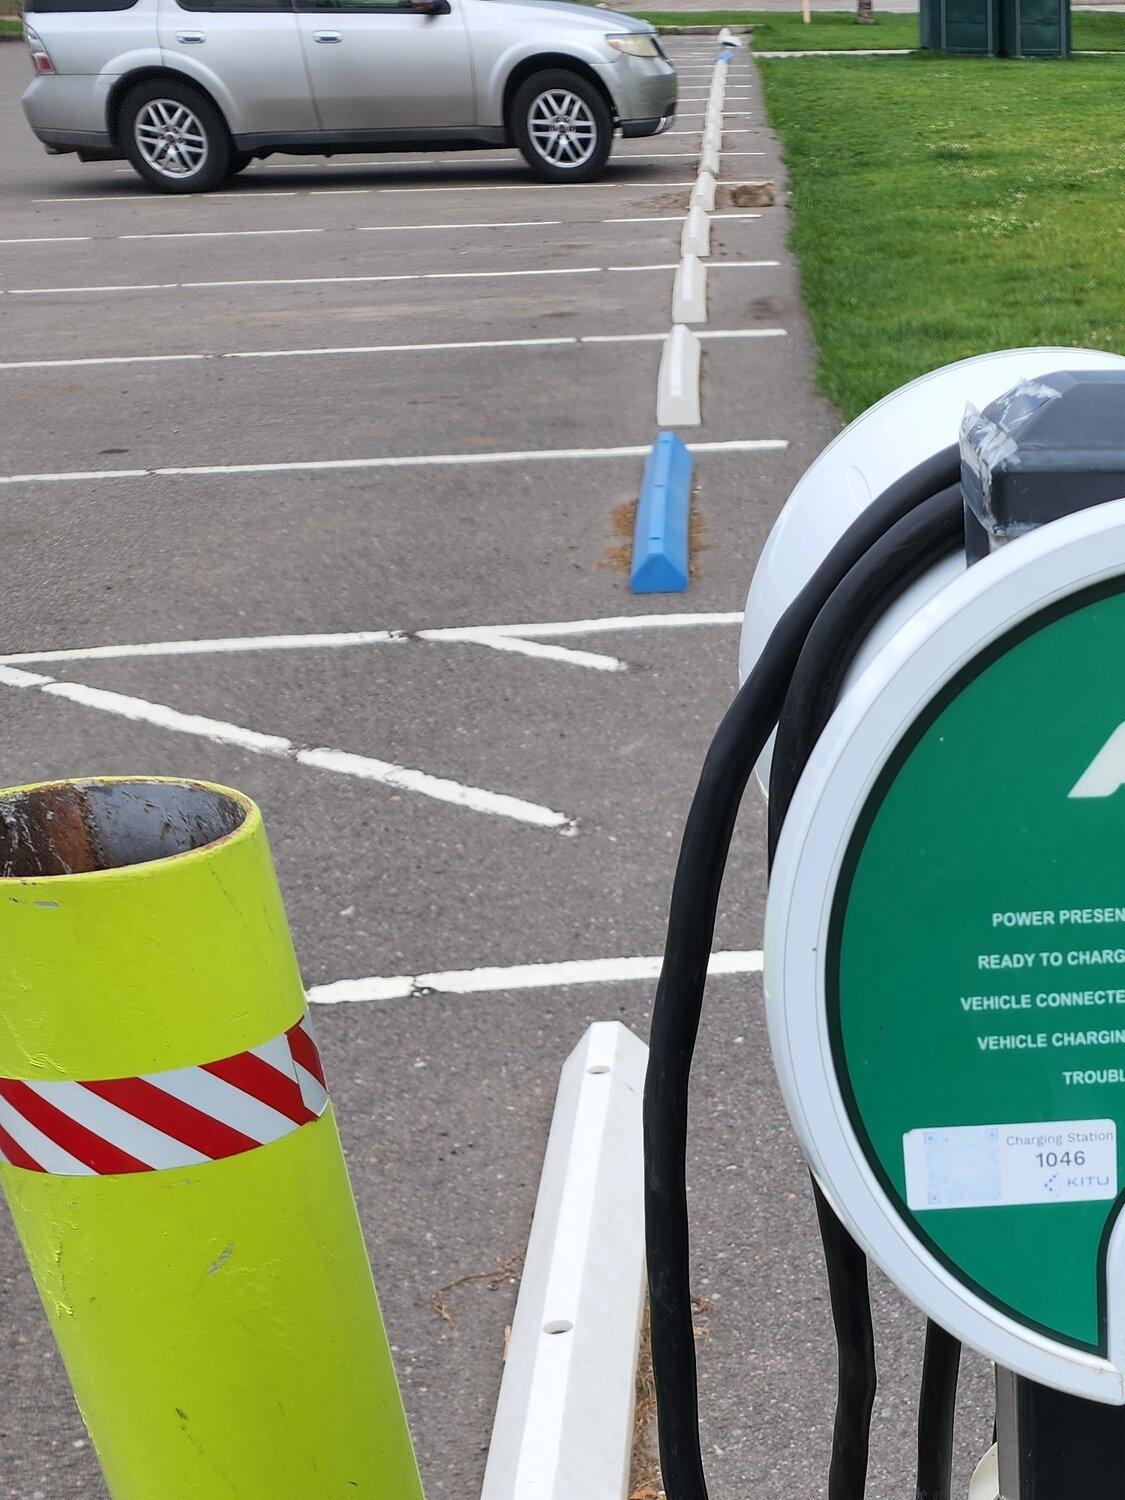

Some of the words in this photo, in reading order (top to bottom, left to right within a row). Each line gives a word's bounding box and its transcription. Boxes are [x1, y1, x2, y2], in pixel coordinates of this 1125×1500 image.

[992, 911, 1055, 928] POWER
[977, 953, 1036, 970] READY
[1039, 951, 1063, 967] TO
[960, 994, 1032, 1011] VEHICLE
[977, 1033, 1048, 1051] VEHICLE
[1006, 1134, 1063, 1147] Charging
[1067, 1131, 1114, 1143] Station
[1035, 1150, 1086, 1168] 1046
